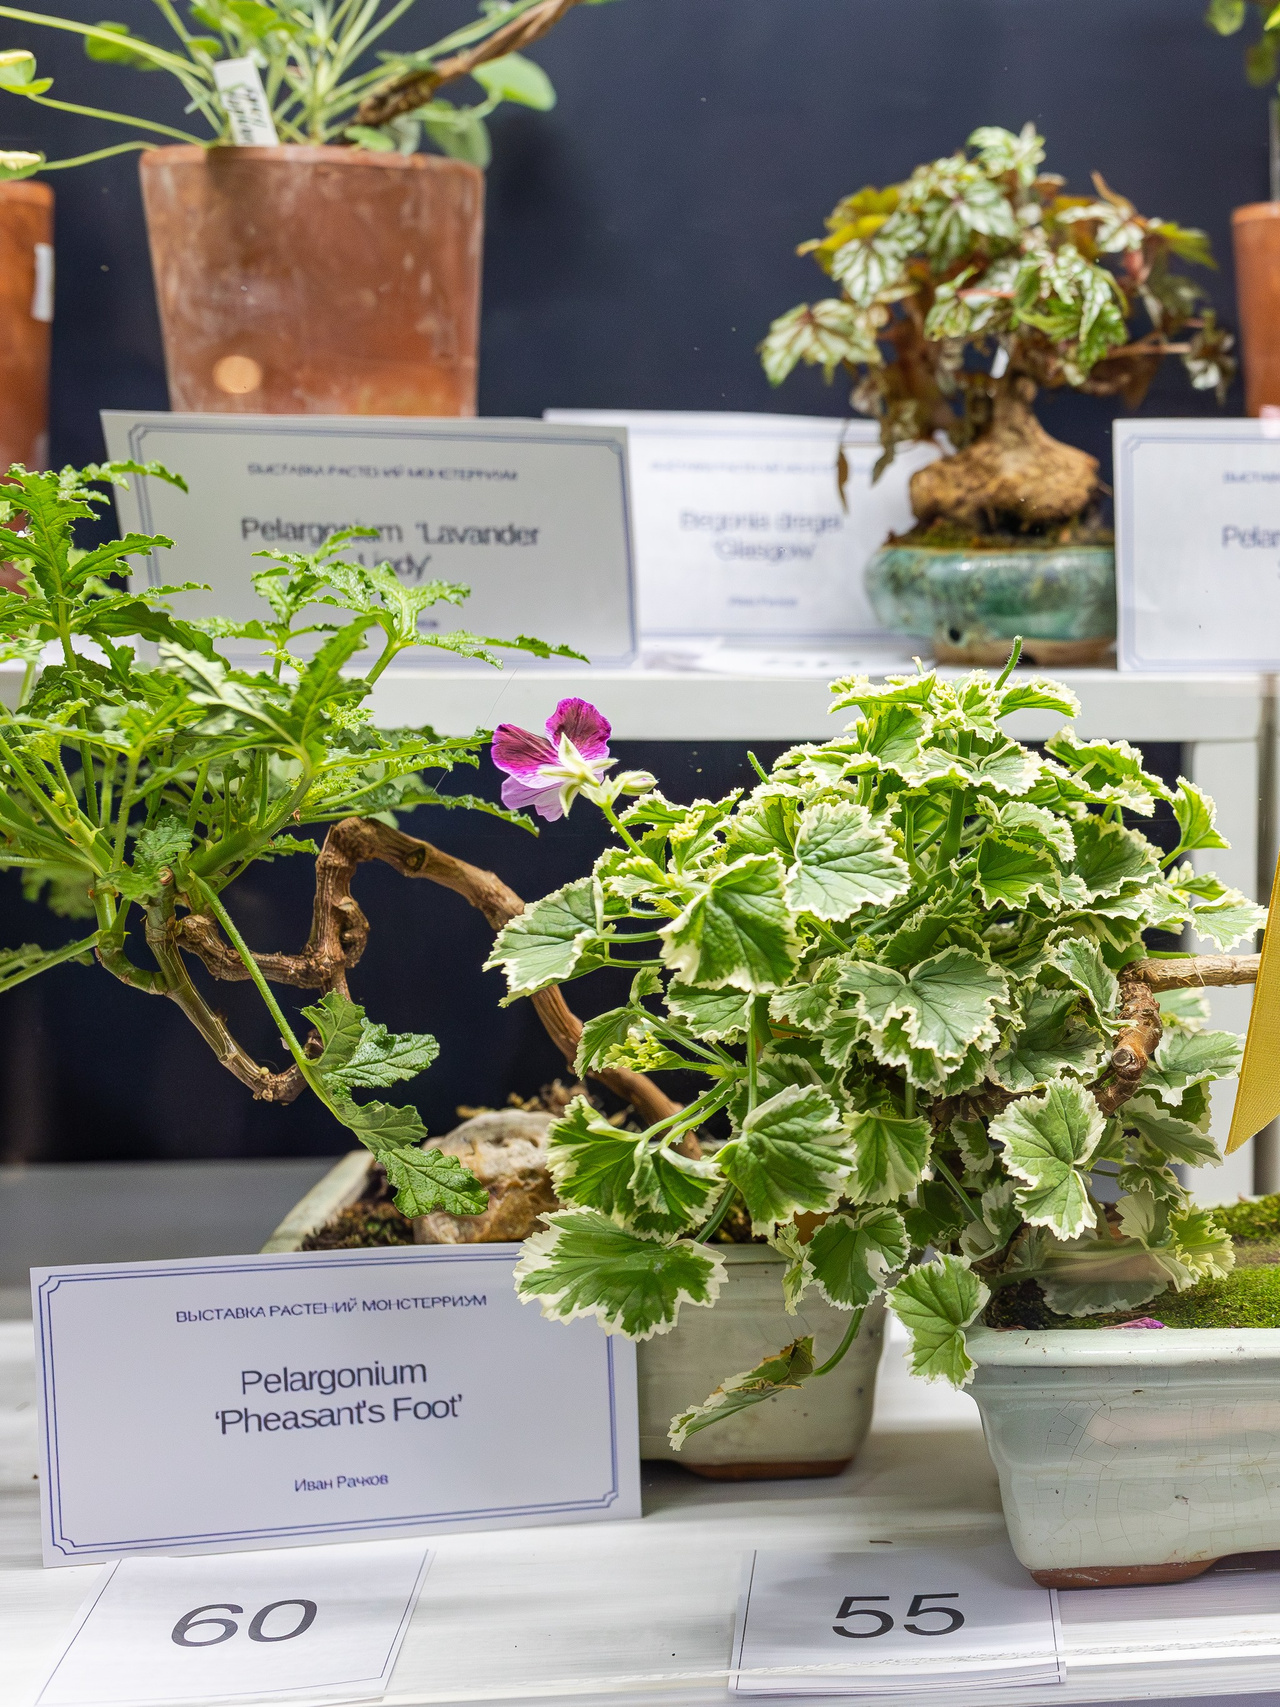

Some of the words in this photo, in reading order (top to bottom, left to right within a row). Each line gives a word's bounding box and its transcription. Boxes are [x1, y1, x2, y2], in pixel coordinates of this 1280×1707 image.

[176, 1306, 266, 1323] ВЫСТАВКА
[269, 1297, 358, 1318] РАСТЕНИЙ
[362, 1294, 488, 1312] МОНСТЕРРИУМ
[240, 1360, 428, 1396] Pelargonium
[294, 1478, 334, 1493] Иван
[336, 1474, 389, 1490] Рачков
[170, 1598, 318, 1649] 60
[832, 1592, 965, 1639] 55
